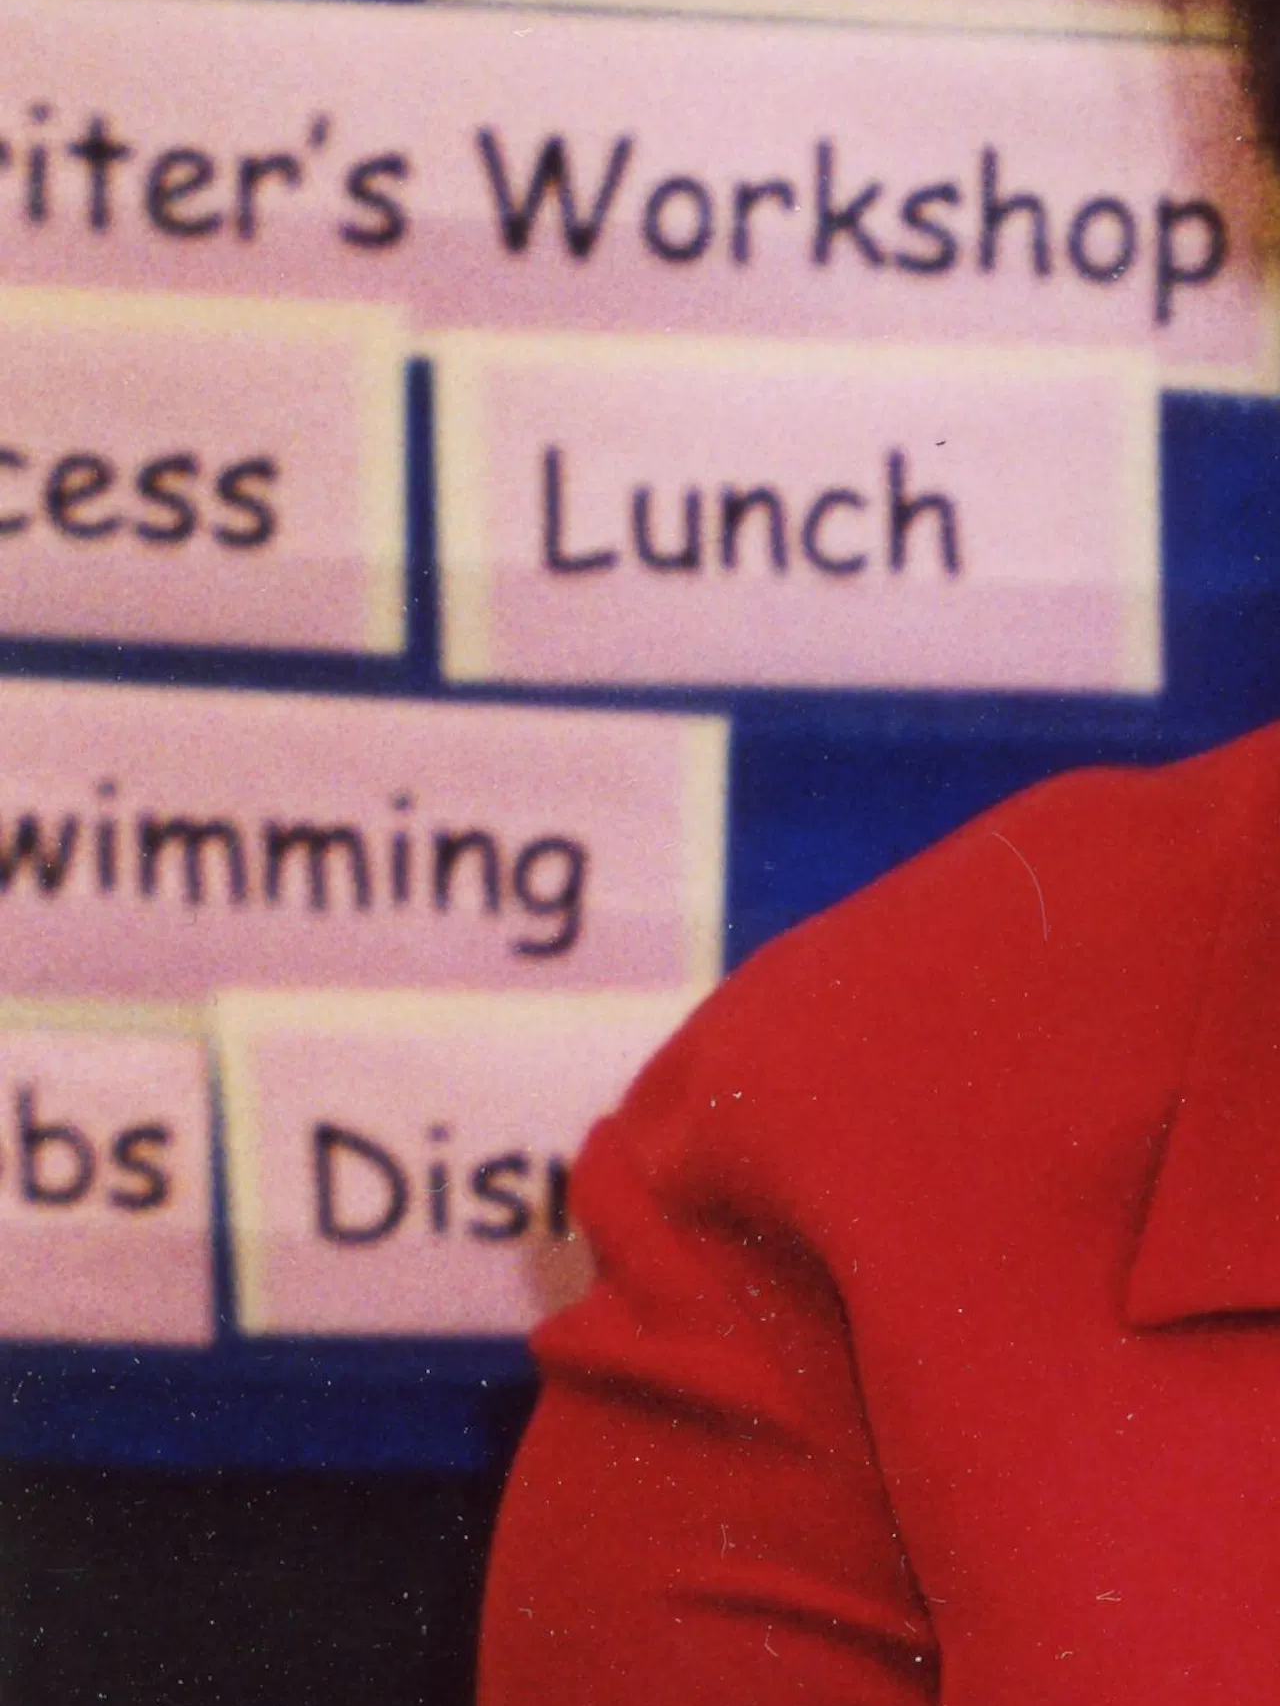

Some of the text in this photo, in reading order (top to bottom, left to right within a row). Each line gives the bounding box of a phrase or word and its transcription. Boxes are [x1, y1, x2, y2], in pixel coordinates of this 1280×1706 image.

[0, 104, 1230, 325] iter's Workshop
[541, 445, 965, 579] Lunch
[0, 1081, 173, 1211] bs
